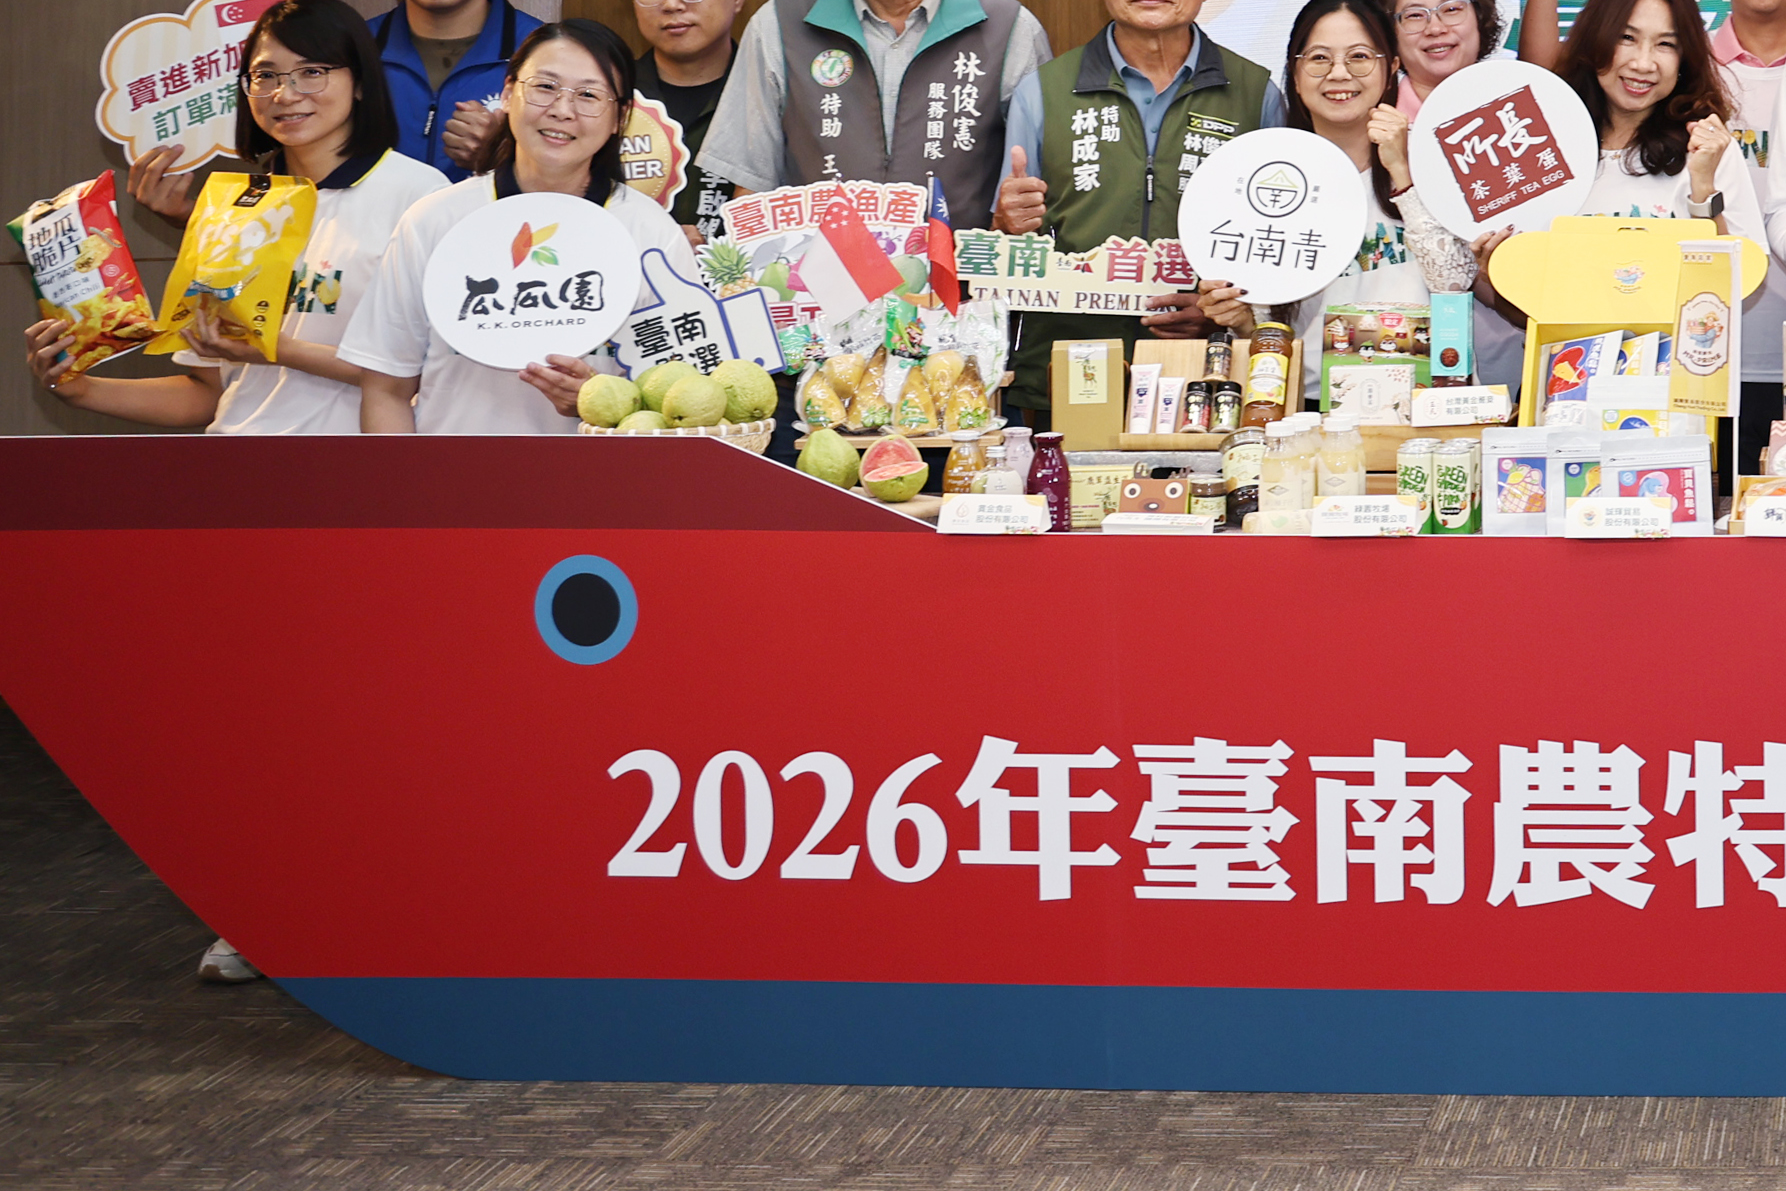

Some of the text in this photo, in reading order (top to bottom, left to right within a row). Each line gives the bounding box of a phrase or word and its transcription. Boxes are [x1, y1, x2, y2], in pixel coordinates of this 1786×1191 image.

[819, 92, 843, 138] 特助
[923, 82, 949, 160] 服務團隊
[952, 51, 986, 152] 林俊憲
[1100, 104, 1121, 143] 特助
[1070, 107, 1101, 192] 林成家
[1183, 131, 1228, 155] 林俊
[1202, 120, 1236, 134] DPP
[1469, 147, 1559, 201] 茶葉蛋
[1477, 169, 1565, 215] SHERIFF TEA EGG
[29, 212, 78, 251] 地瓜
[31, 235, 82, 274] 脆片
[1209, 219, 1328, 271] 台南青
[957, 231, 1051, 279] 臺南
[1105, 239, 1197, 286] 首選
[511, 317, 587, 329] ORCHARD
[630, 310, 707, 359] 臺南
[1353, 514, 1408, 524] 股份有限公司
[1604, 517, 1659, 527] 股份有限公司
